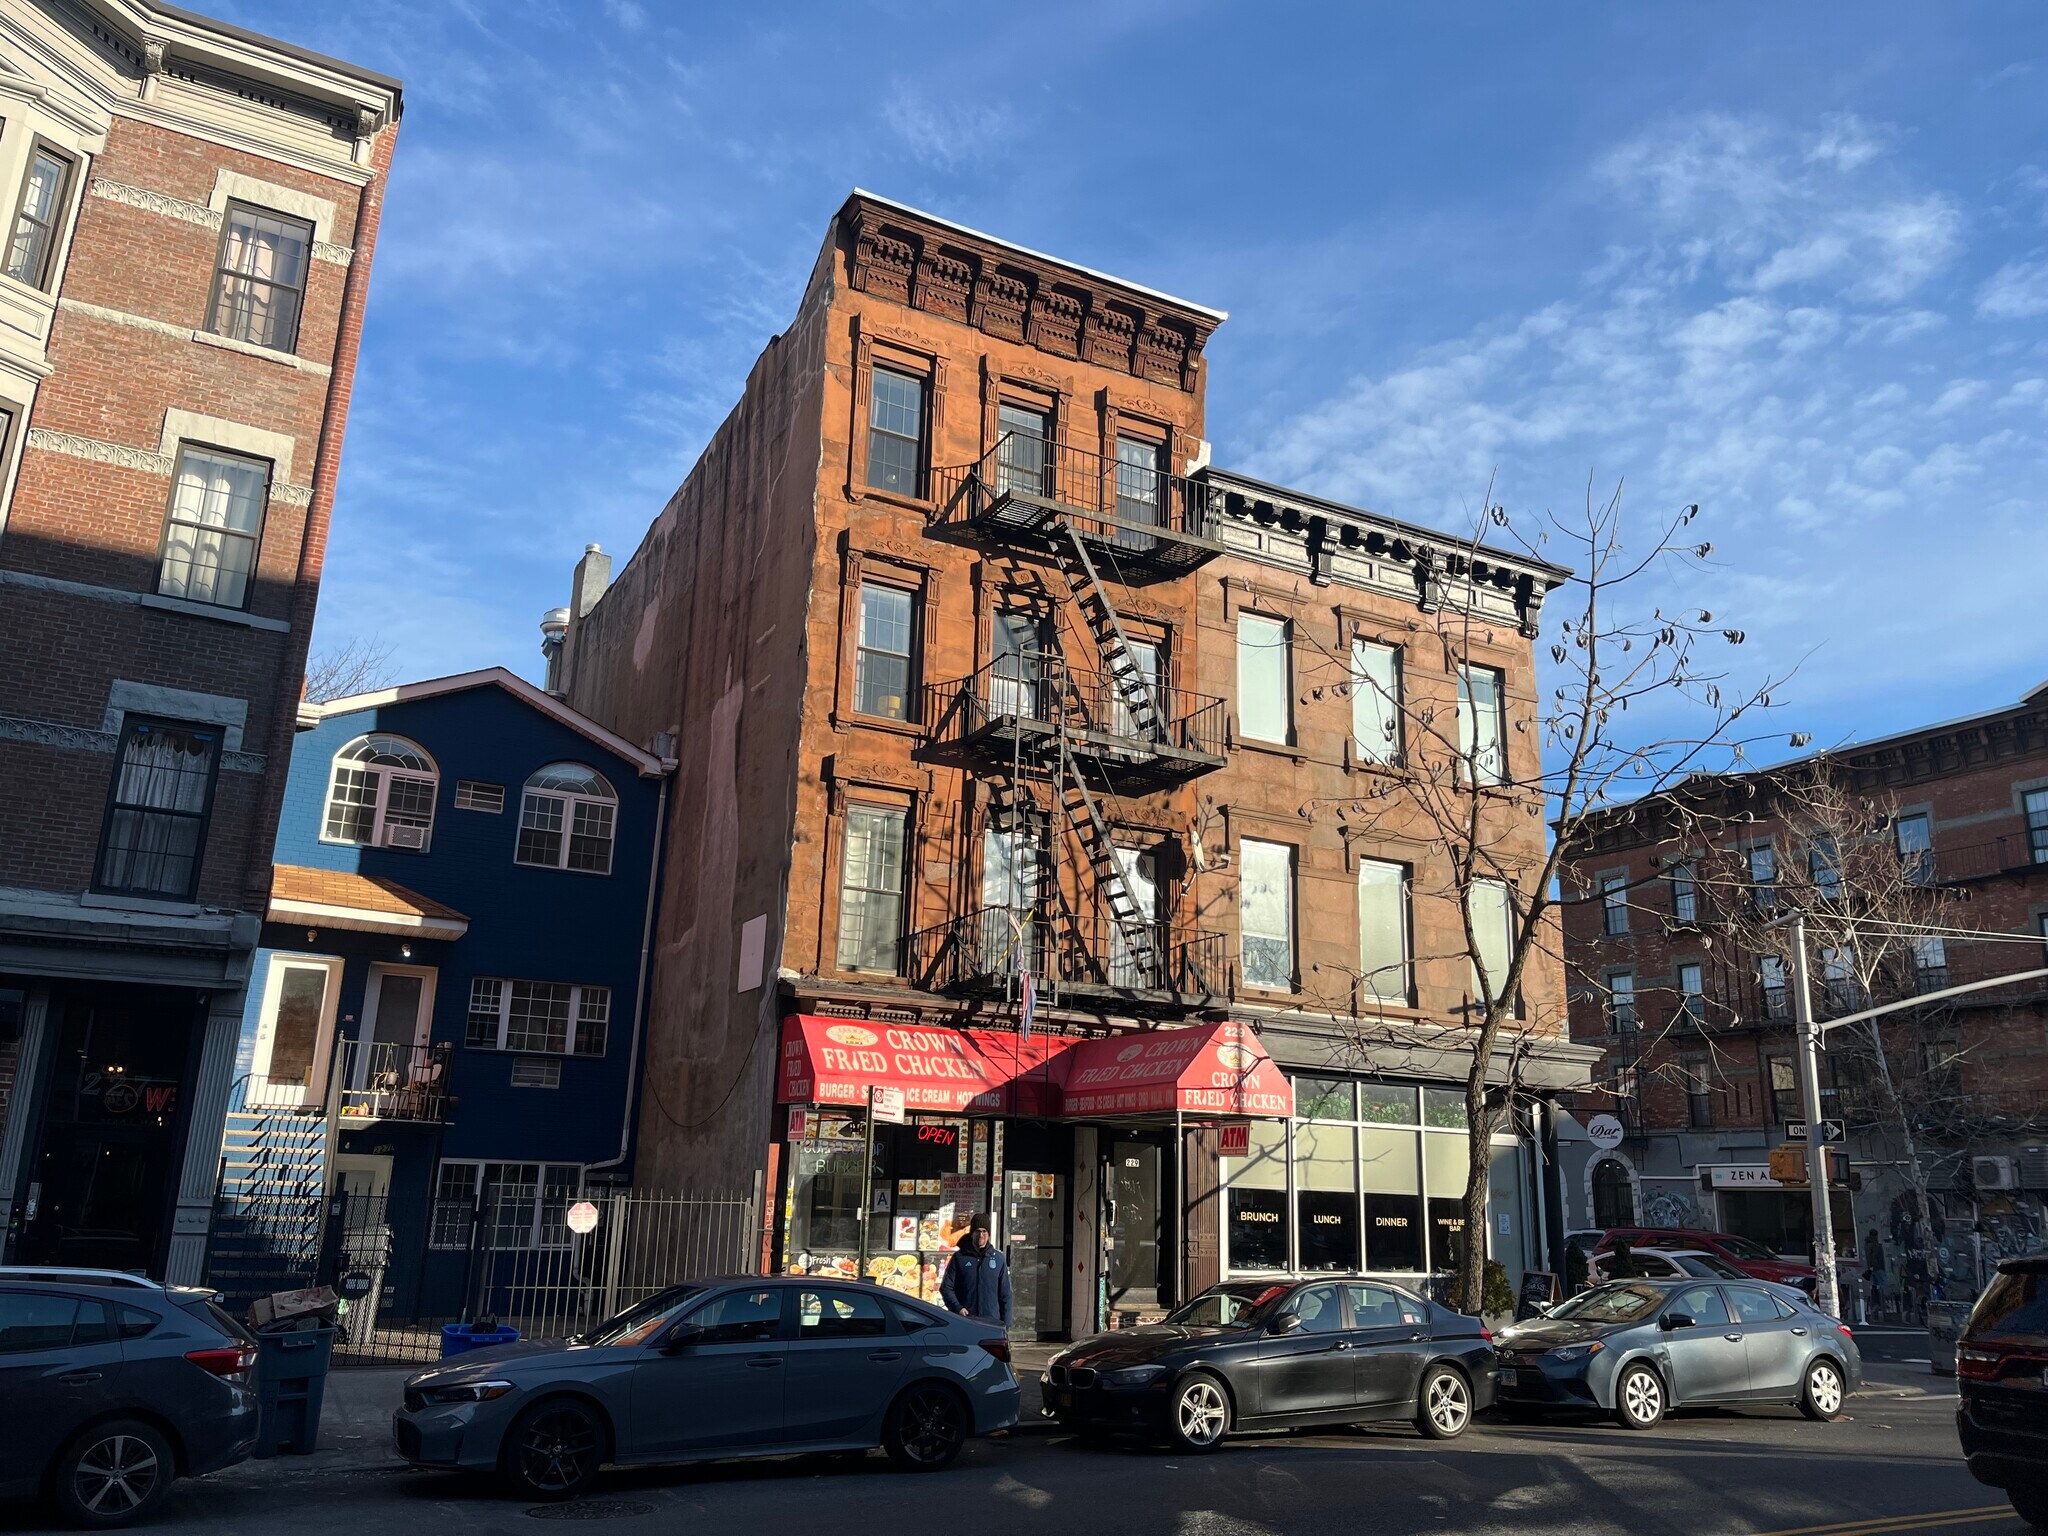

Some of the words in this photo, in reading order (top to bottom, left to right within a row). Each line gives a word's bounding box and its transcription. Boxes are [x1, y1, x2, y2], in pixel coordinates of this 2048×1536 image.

[1224, 1026, 1245, 1037] 229
[786, 1040, 804, 1057] CROWN
[886, 1029, 963, 1055] CROWN
[1145, 1036, 1206, 1057] CROWN
[787, 1060, 802, 1077] FRIED
[821, 1047, 888, 1072] FRIED
[895, 1054, 987, 1080] CHICKEN
[1074, 1066, 1121, 1083] FRIED
[1119, 1058, 1189, 1080] CHICKEN
[789, 1079, 810, 1097] CHICKEN
[1211, 1072, 1260, 1089] CROWN
[819, 1082, 854, 1099] BURGER
[906, 1088, 920, 1102] ICE
[923, 1089, 950, 1104] CREAM
[957, 1093, 974, 1106] HOT
[975, 1092, 1000, 1107] WINGS
[1185, 1089, 1225, 1107] FRIED
[1230, 1093, 1286, 1110] CHICKEN
[790, 1110, 805, 1132] ATM
[918, 1125, 955, 1145] OPEN
[1221, 1127, 1247, 1147] ATM
[1590, 1125, 1620, 1136] Dar
[1126, 1159, 1139, 1167] 229
[1731, 1171, 1754, 1180] ZEN
[877, 1192, 887, 1205] A
[1240, 1211, 1278, 1222] BRUNCH
[1313, 1215, 1341, 1224] LUNCH
[1376, 1217, 1407, 1227] DINNER
[812, 1256, 830, 1265] Fresh
